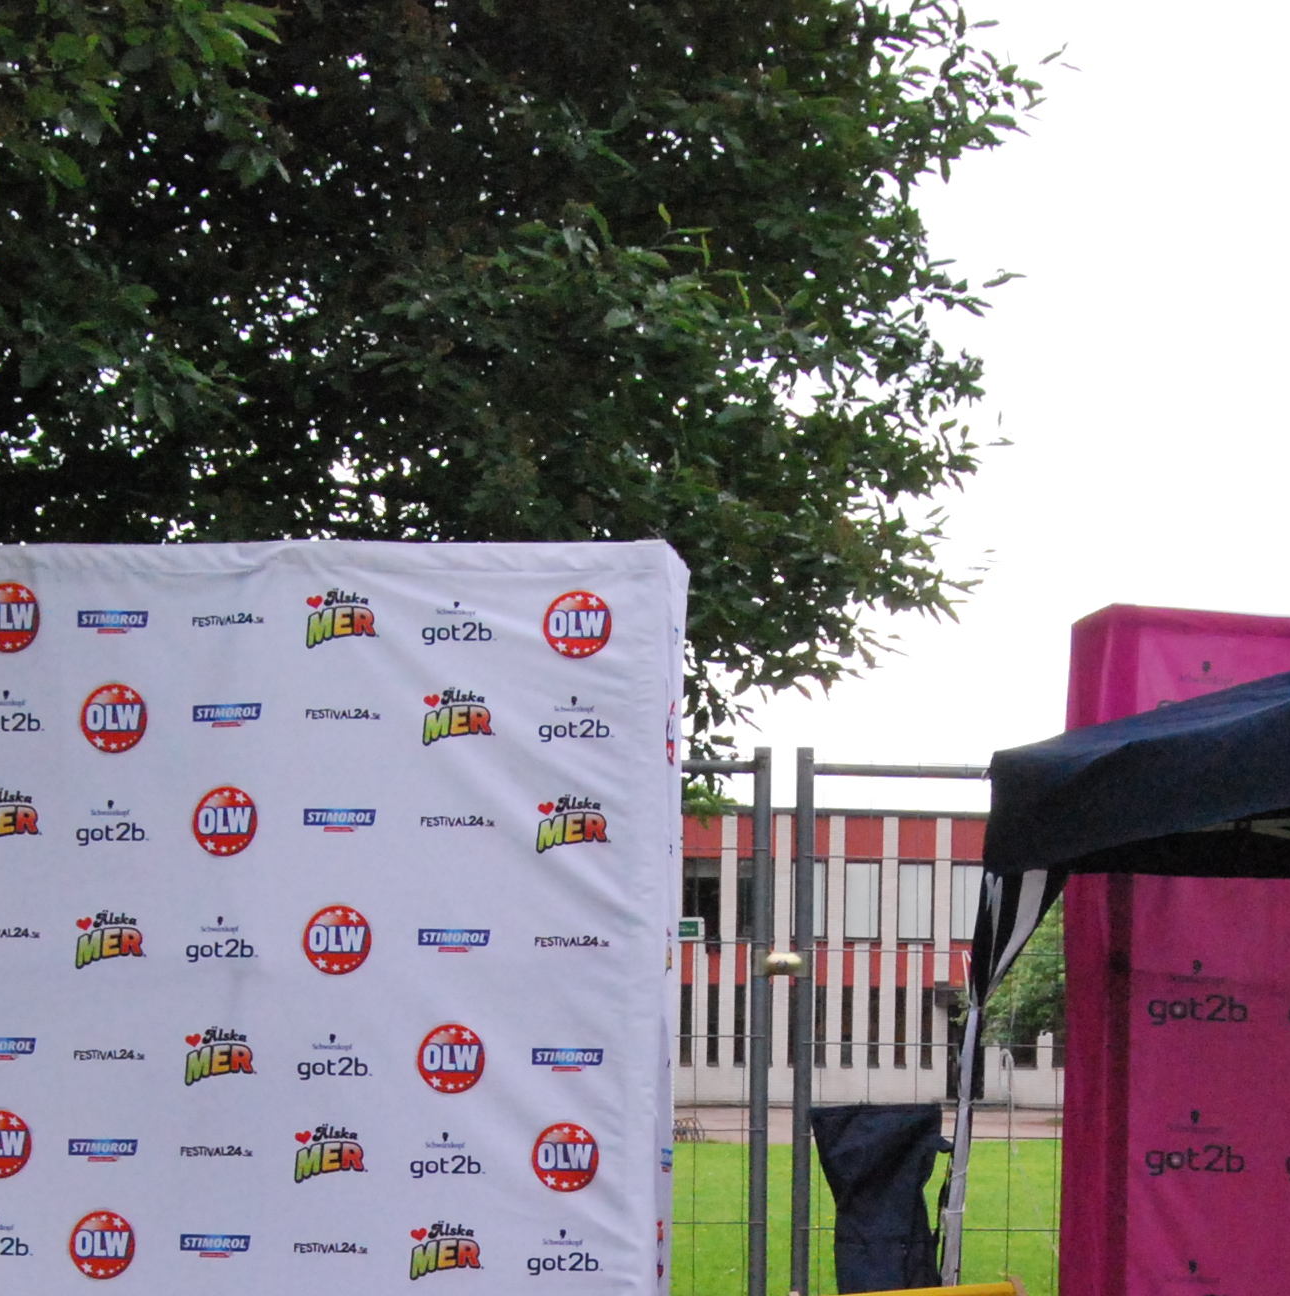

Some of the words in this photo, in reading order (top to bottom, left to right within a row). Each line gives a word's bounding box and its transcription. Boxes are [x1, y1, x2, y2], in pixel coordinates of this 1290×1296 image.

[80, 612, 147, 627] STIMOROL
[306, 604, 377, 650] MER
[422, 621, 493, 646] got2b
[549, 610, 605, 638] OLW
[85, 702, 141, 731] OLW
[195, 705, 260, 720] STIMOROL
[422, 703, 493, 747] MER
[539, 718, 610, 743] got2b
[197, 806, 252, 835] OLW
[306, 810, 374, 825] STIMOROL
[76, 822, 147, 847] got2b
[536, 810, 607, 856] MER
[75, 926, 146, 971] MER
[186, 939, 257, 964] got2b
[308, 924, 365, 953] OLW
[421, 930, 488, 945] STIMOROL
[1147, 994, 1248, 1026] got2b
[184, 1042, 255, 1087] MER
[297, 1056, 368, 1081] got2b
[422, 1043, 479, 1071] OLW
[535, 1050, 602, 1065] STIMOROL
[71, 1140, 136, 1155] STIMOROL
[537, 1143, 592, 1171] OLW
[1144, 1144, 1246, 1176] got2b
[294, 1139, 365, 1185] MER
[410, 1155, 481, 1180] got2b
[74, 1230, 129, 1258] OLW
[183, 1235, 249, 1250] STIMOROL
[409, 1237, 480, 1282] MER
[527, 1252, 598, 1277] got2b
